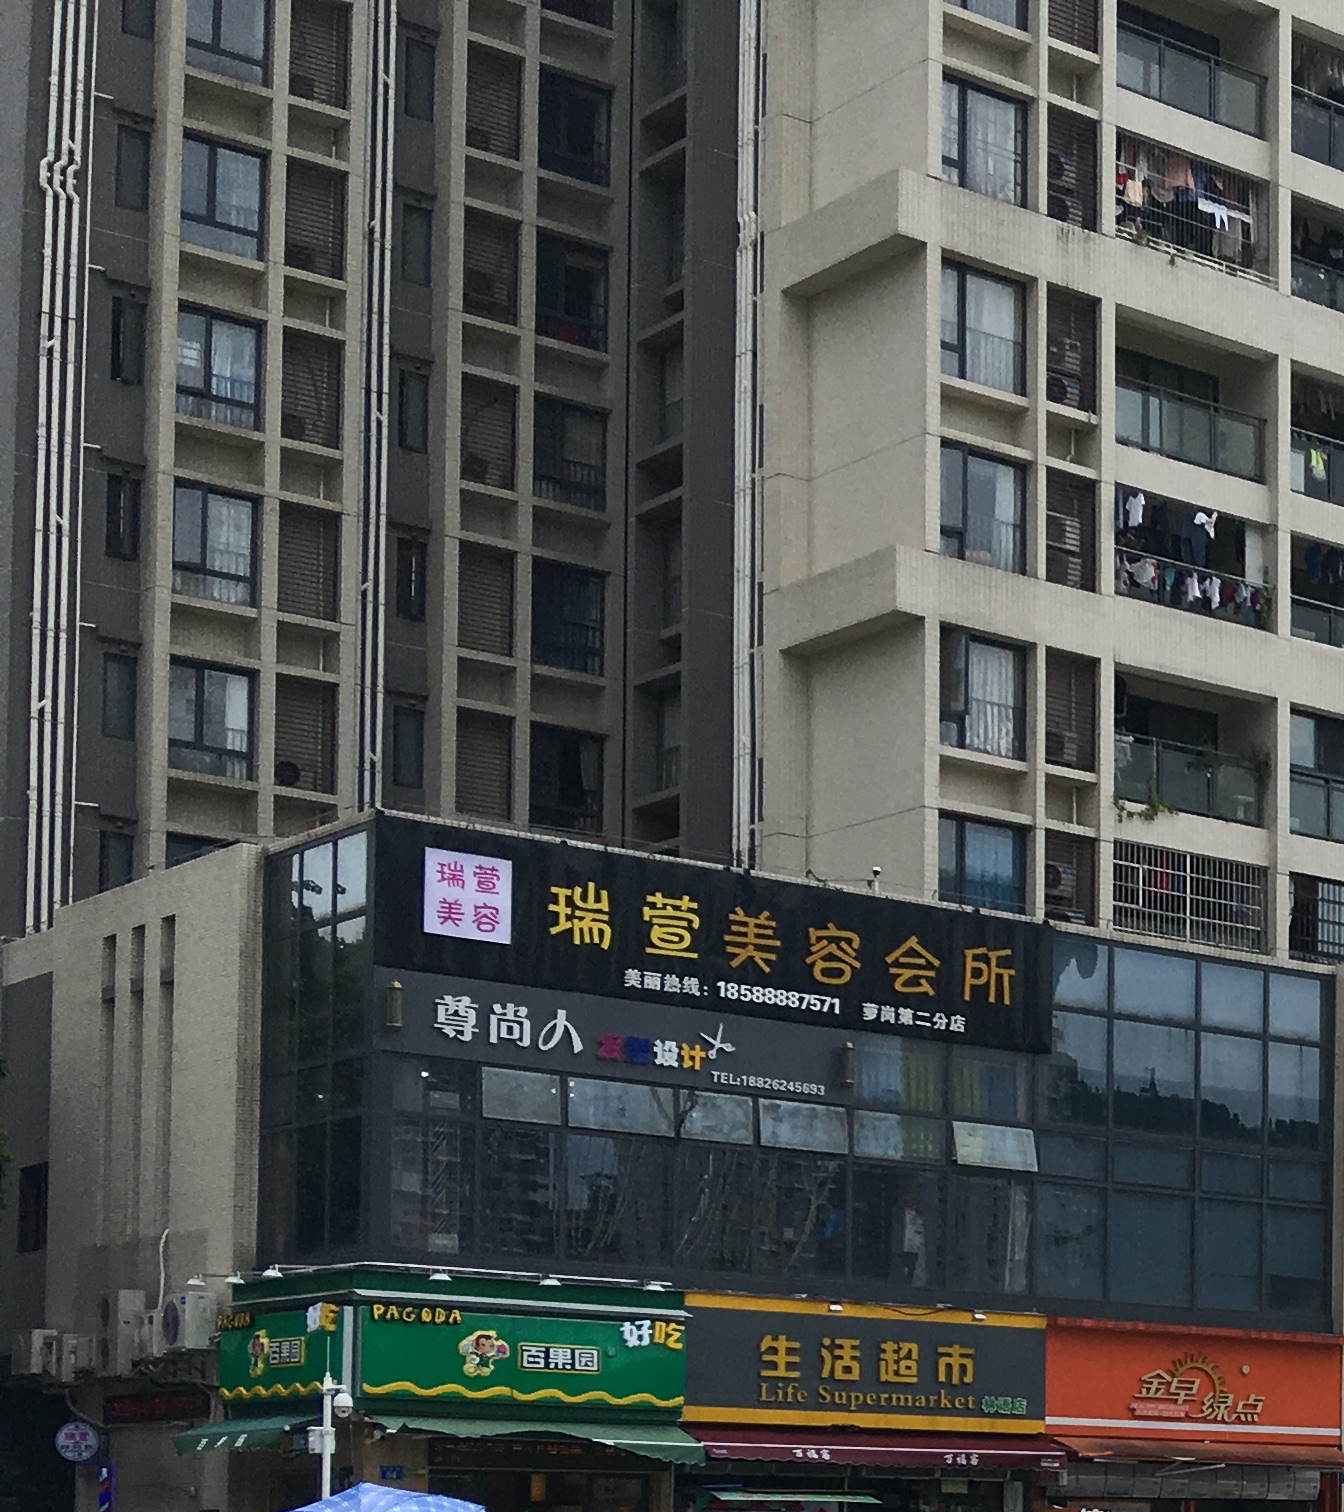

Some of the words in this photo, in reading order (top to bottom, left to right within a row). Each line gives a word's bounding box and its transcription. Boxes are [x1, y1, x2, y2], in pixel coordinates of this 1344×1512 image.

[437, 861, 501, 895] 瑞萱
[437, 898, 501, 933] 美容
[547, 882, 1016, 1006] 瑞萱美容会所
[434, 995, 584, 1054] 尊尚人
[372, 1304, 463, 1326] PAGODA
[621, 1319, 685, 1350] 好吃
[521, 1347, 600, 1372] 百果园
[759, 1334, 976, 1386] 生活超市
[759, 1383, 808, 1403] Life
[818, 1385, 976, 1411] Supermarket
